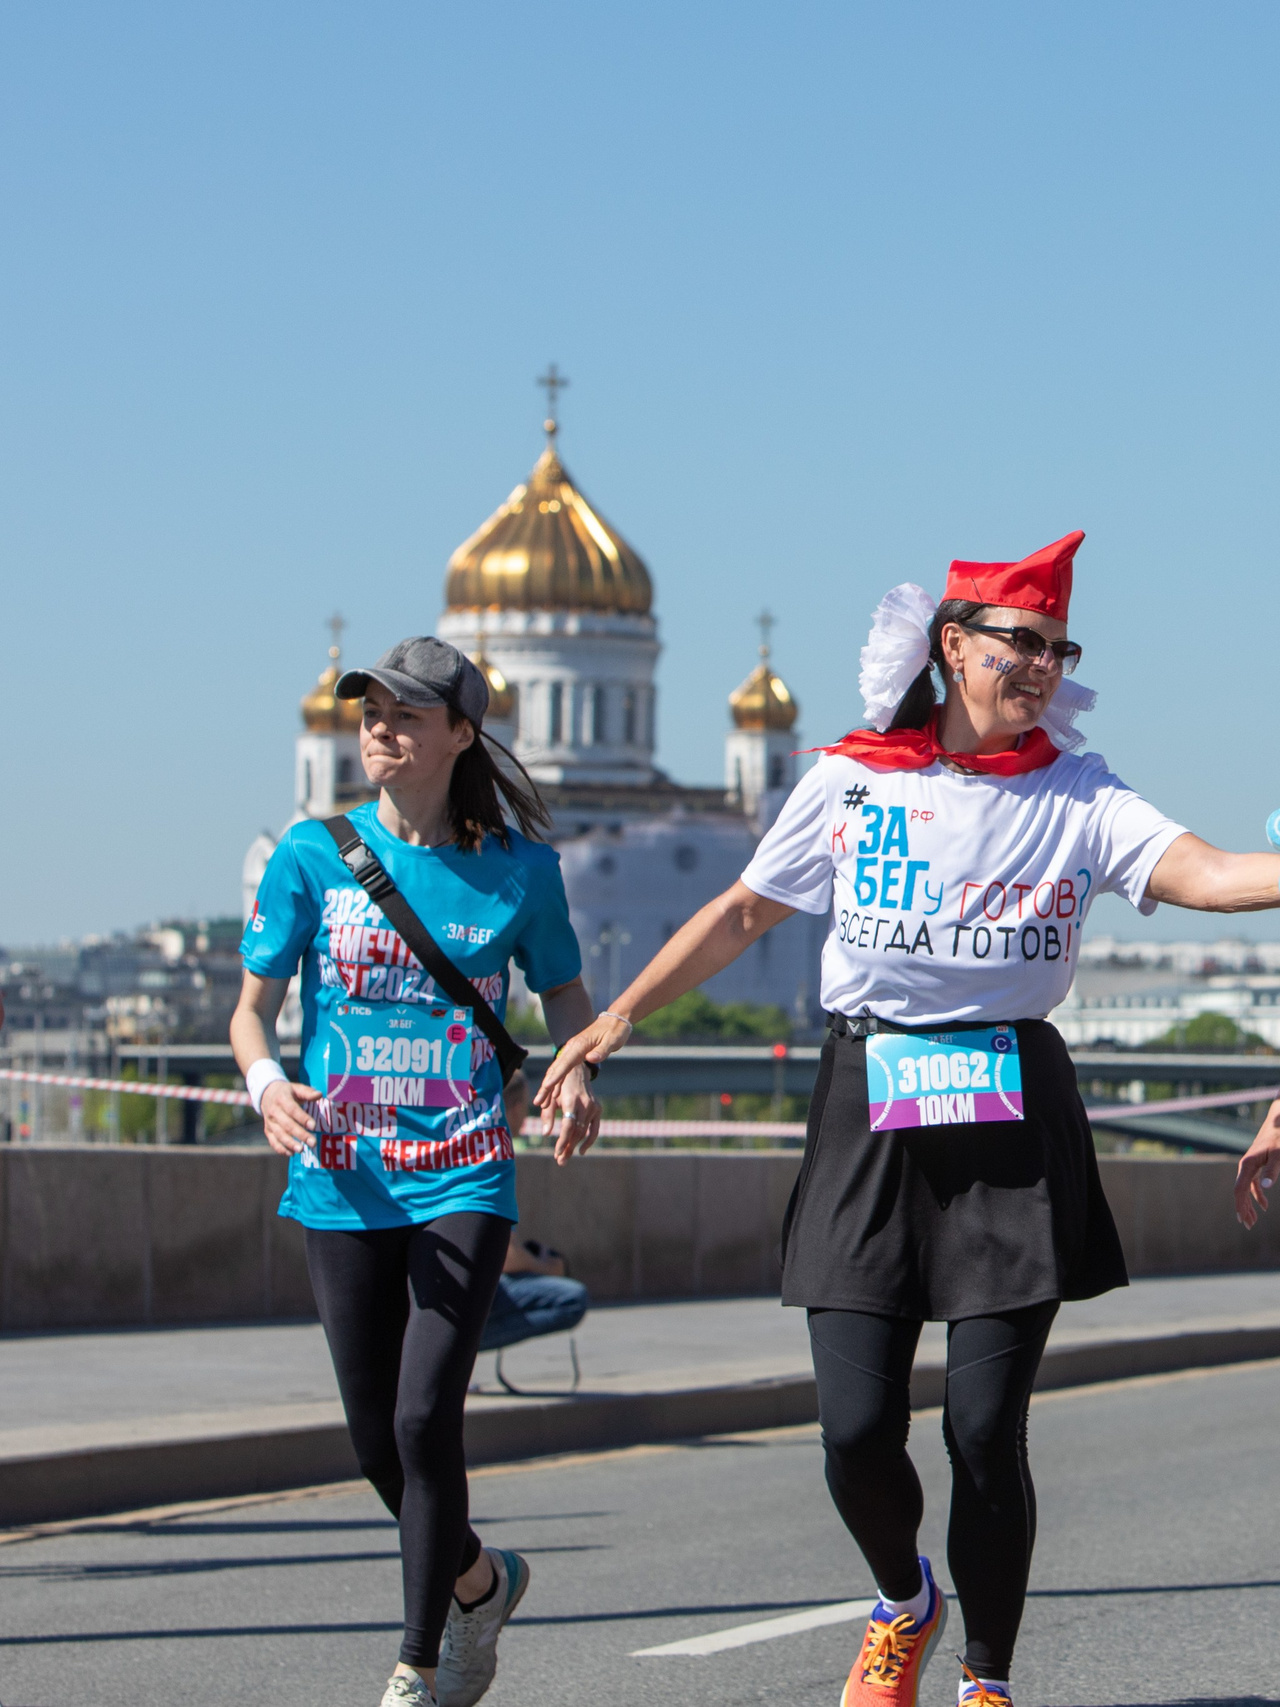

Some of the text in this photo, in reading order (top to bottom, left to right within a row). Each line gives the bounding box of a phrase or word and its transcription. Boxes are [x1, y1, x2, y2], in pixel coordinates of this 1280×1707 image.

[322, 888, 384, 927] 2024
[839, 909, 934, 956] ВСЕГДА
[351, 1006, 372, 1016] ПСБ
[356, 1036, 442, 1074] 32091
[897, 1052, 990, 1094] 31062
